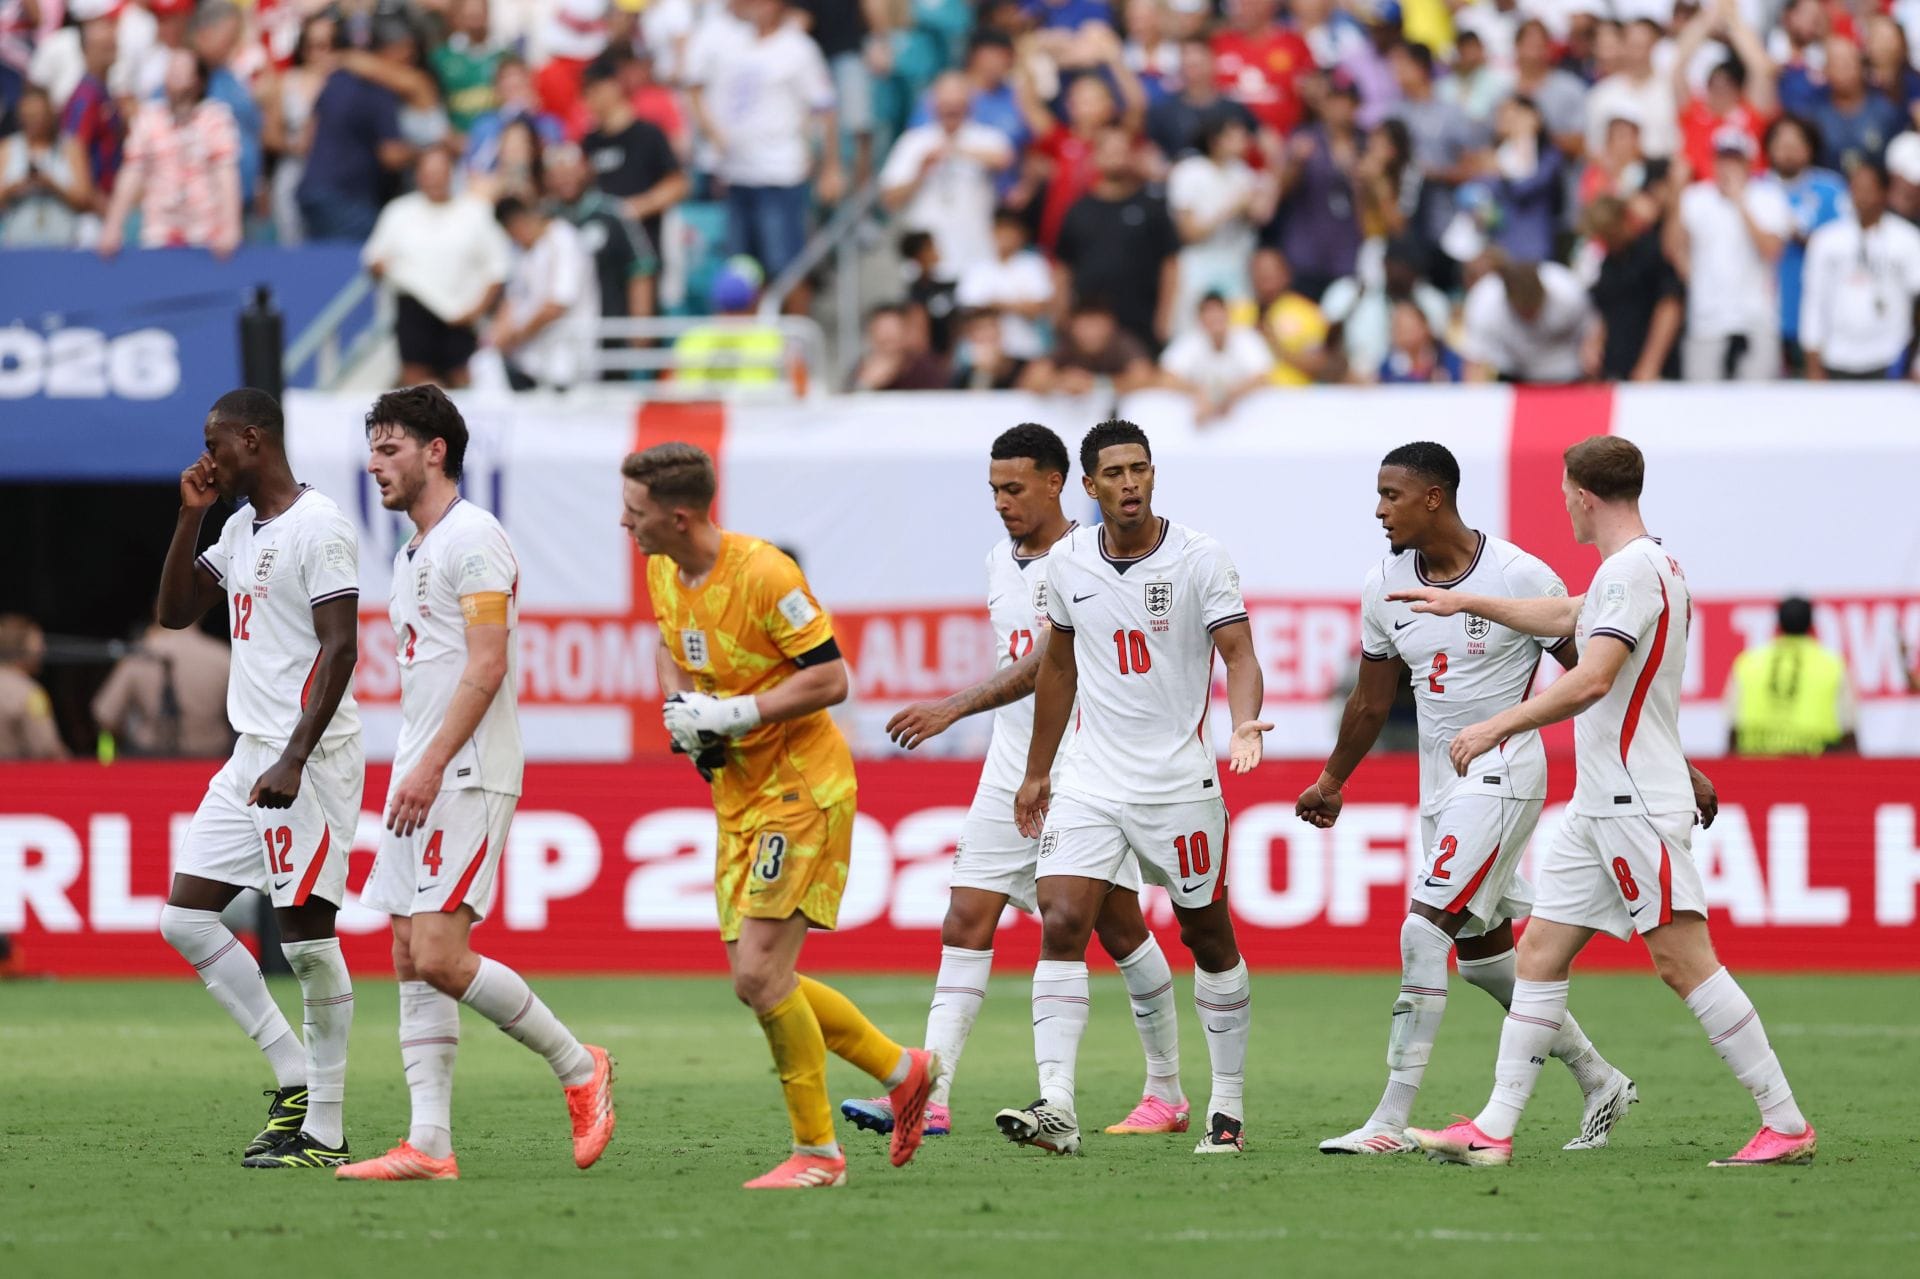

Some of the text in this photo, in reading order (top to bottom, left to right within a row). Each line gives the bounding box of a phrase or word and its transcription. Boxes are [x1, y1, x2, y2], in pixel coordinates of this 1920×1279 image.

[0, 326, 180, 400] 026
[233, 592, 252, 640] 12
[517, 619, 664, 699] ROM
[852, 612, 995, 694] ALB
[1112, 629, 1152, 675] 10
[1429, 652, 1448, 693] 2
[0, 812, 195, 933] RL
[264, 825, 293, 875] 12
[423, 829, 443, 877] 4
[1173, 830, 1211, 879] 10
[1432, 834, 1458, 880] 2
[1612, 856, 1640, 901] 8
